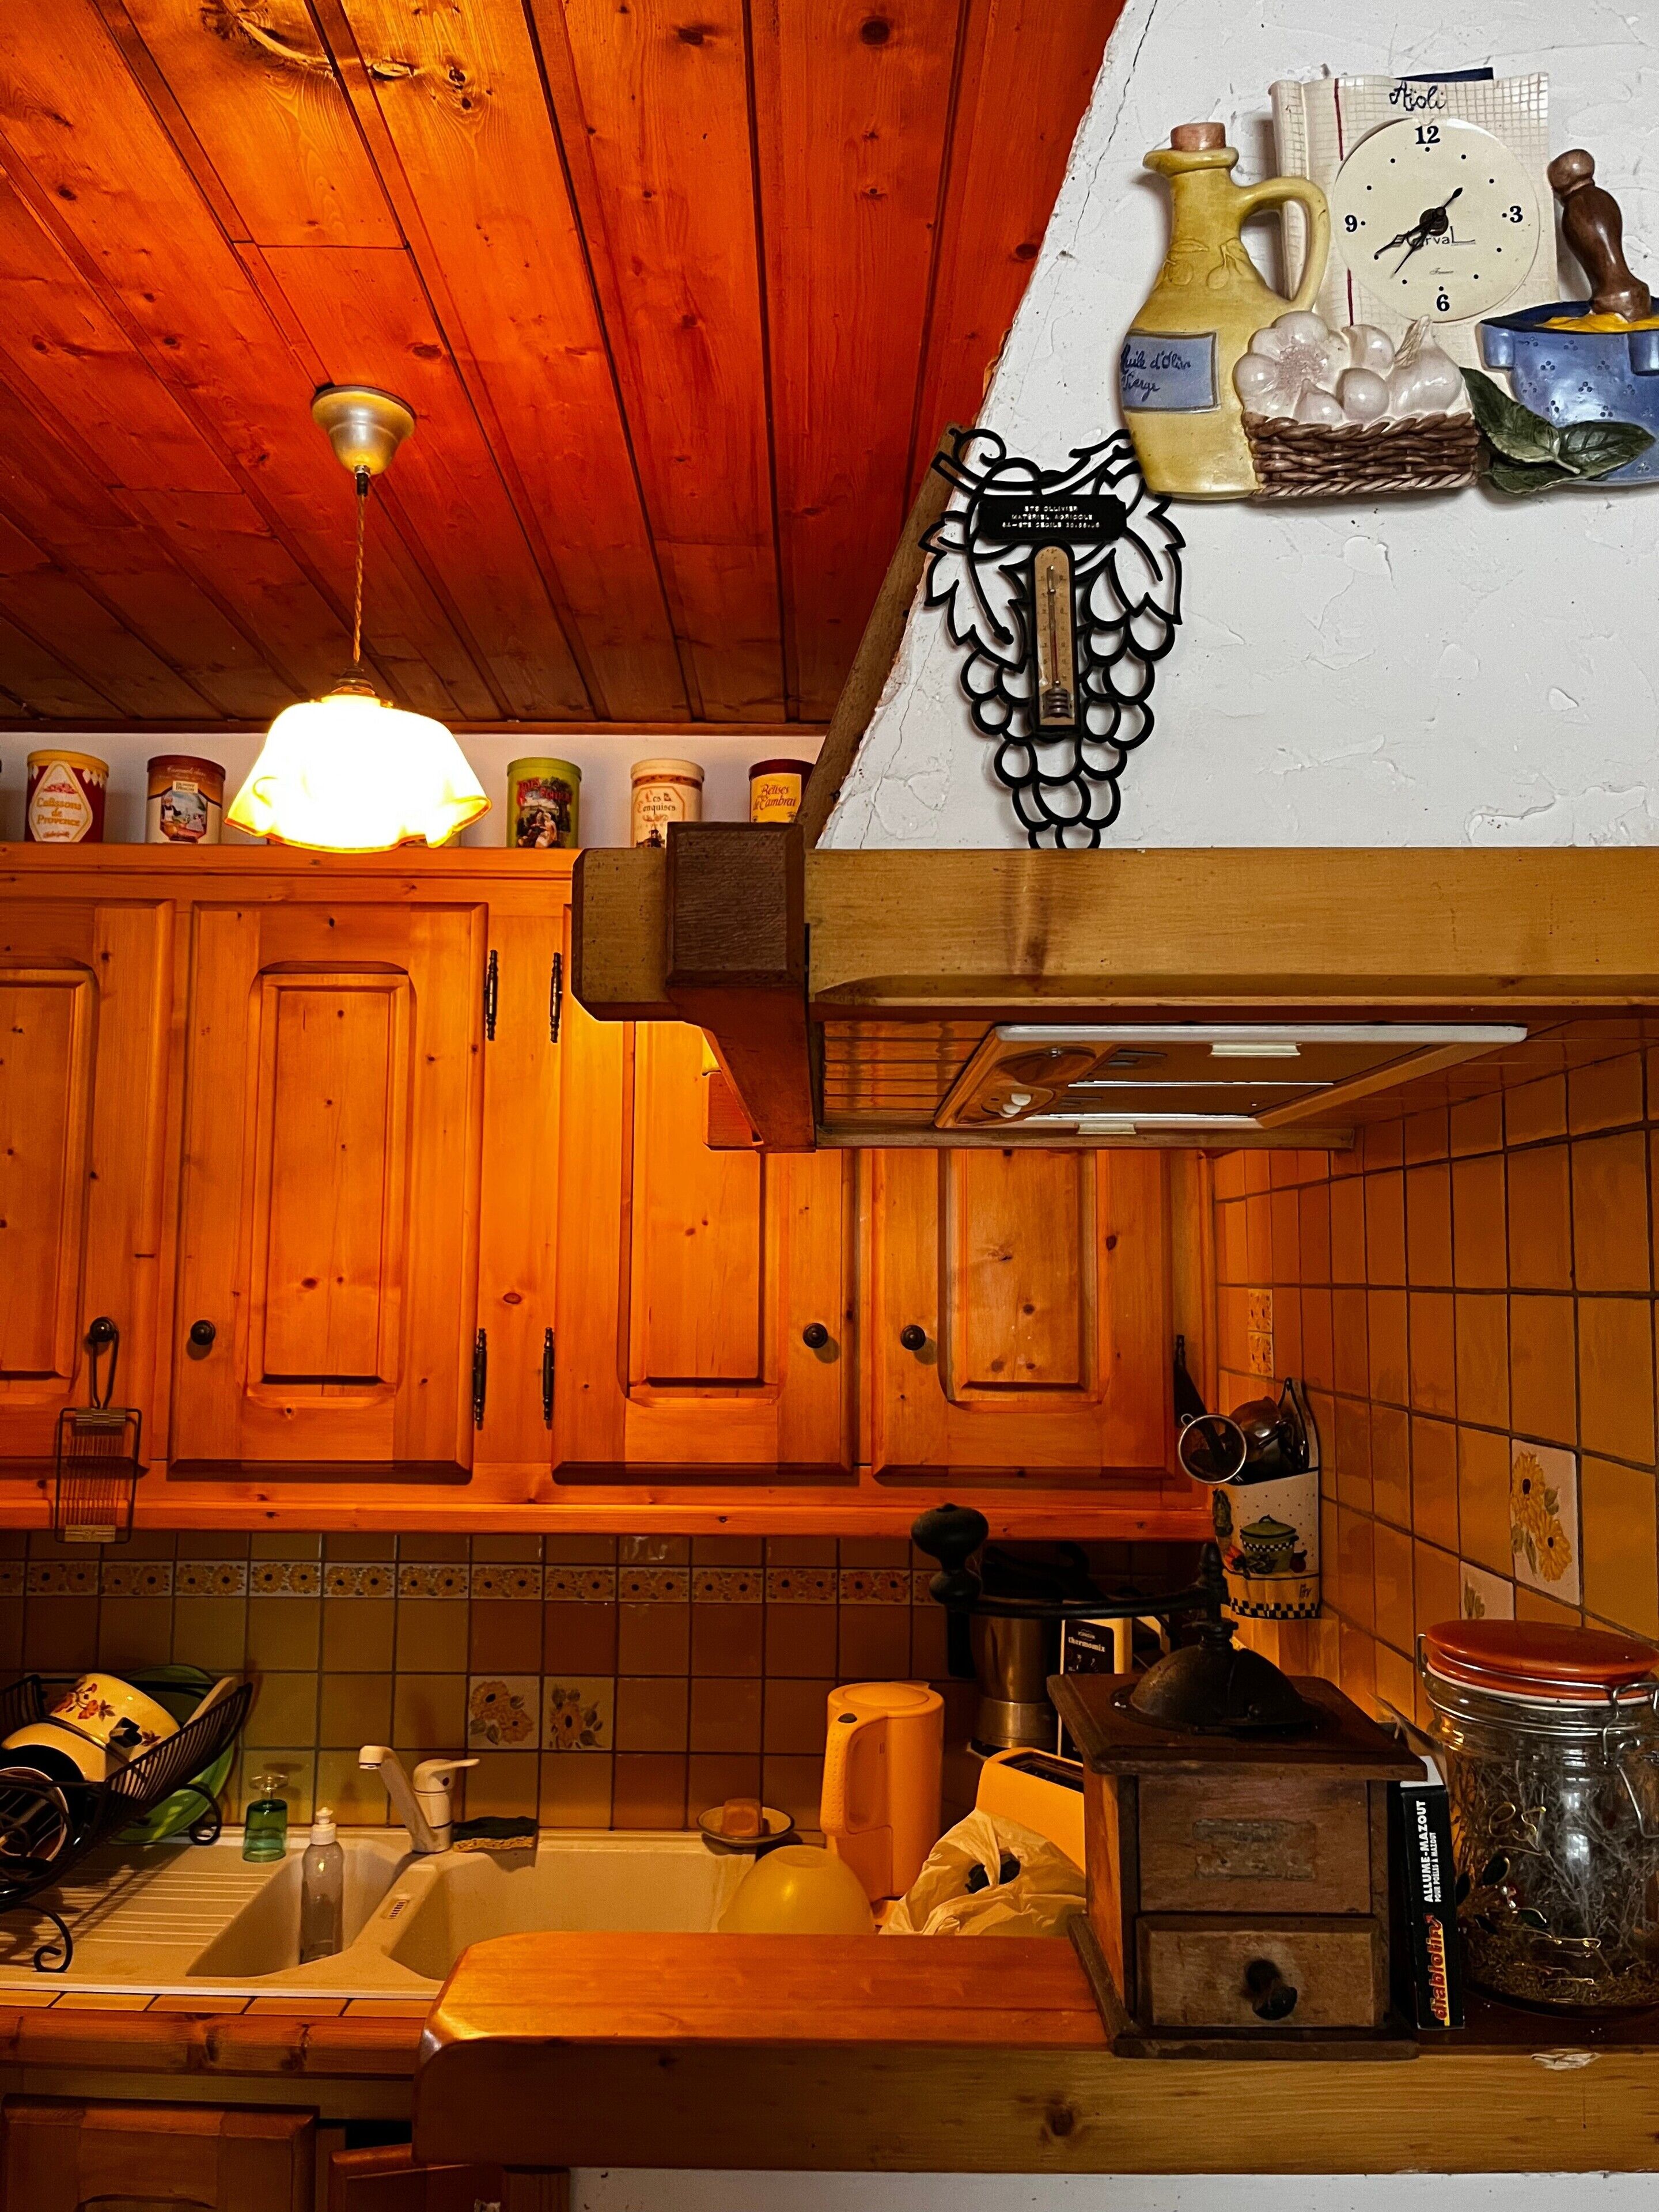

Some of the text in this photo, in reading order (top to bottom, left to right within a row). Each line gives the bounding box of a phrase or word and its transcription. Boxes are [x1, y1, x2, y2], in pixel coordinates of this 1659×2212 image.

[1415, 126, 1441, 145] 12
[1510, 206, 1523, 223] 3
[1344, 215, 1358, 232] 9
[1437, 294, 1450, 312] 6
[37, 814, 80, 826] Provence
[51, 807, 62, 817] de
[1068, 1637, 1105, 1652] thermomix
[1416, 1800, 1434, 1903] ALLUME-MAZOUT
[1429, 1832, 1438, 1857] MAZOUT
